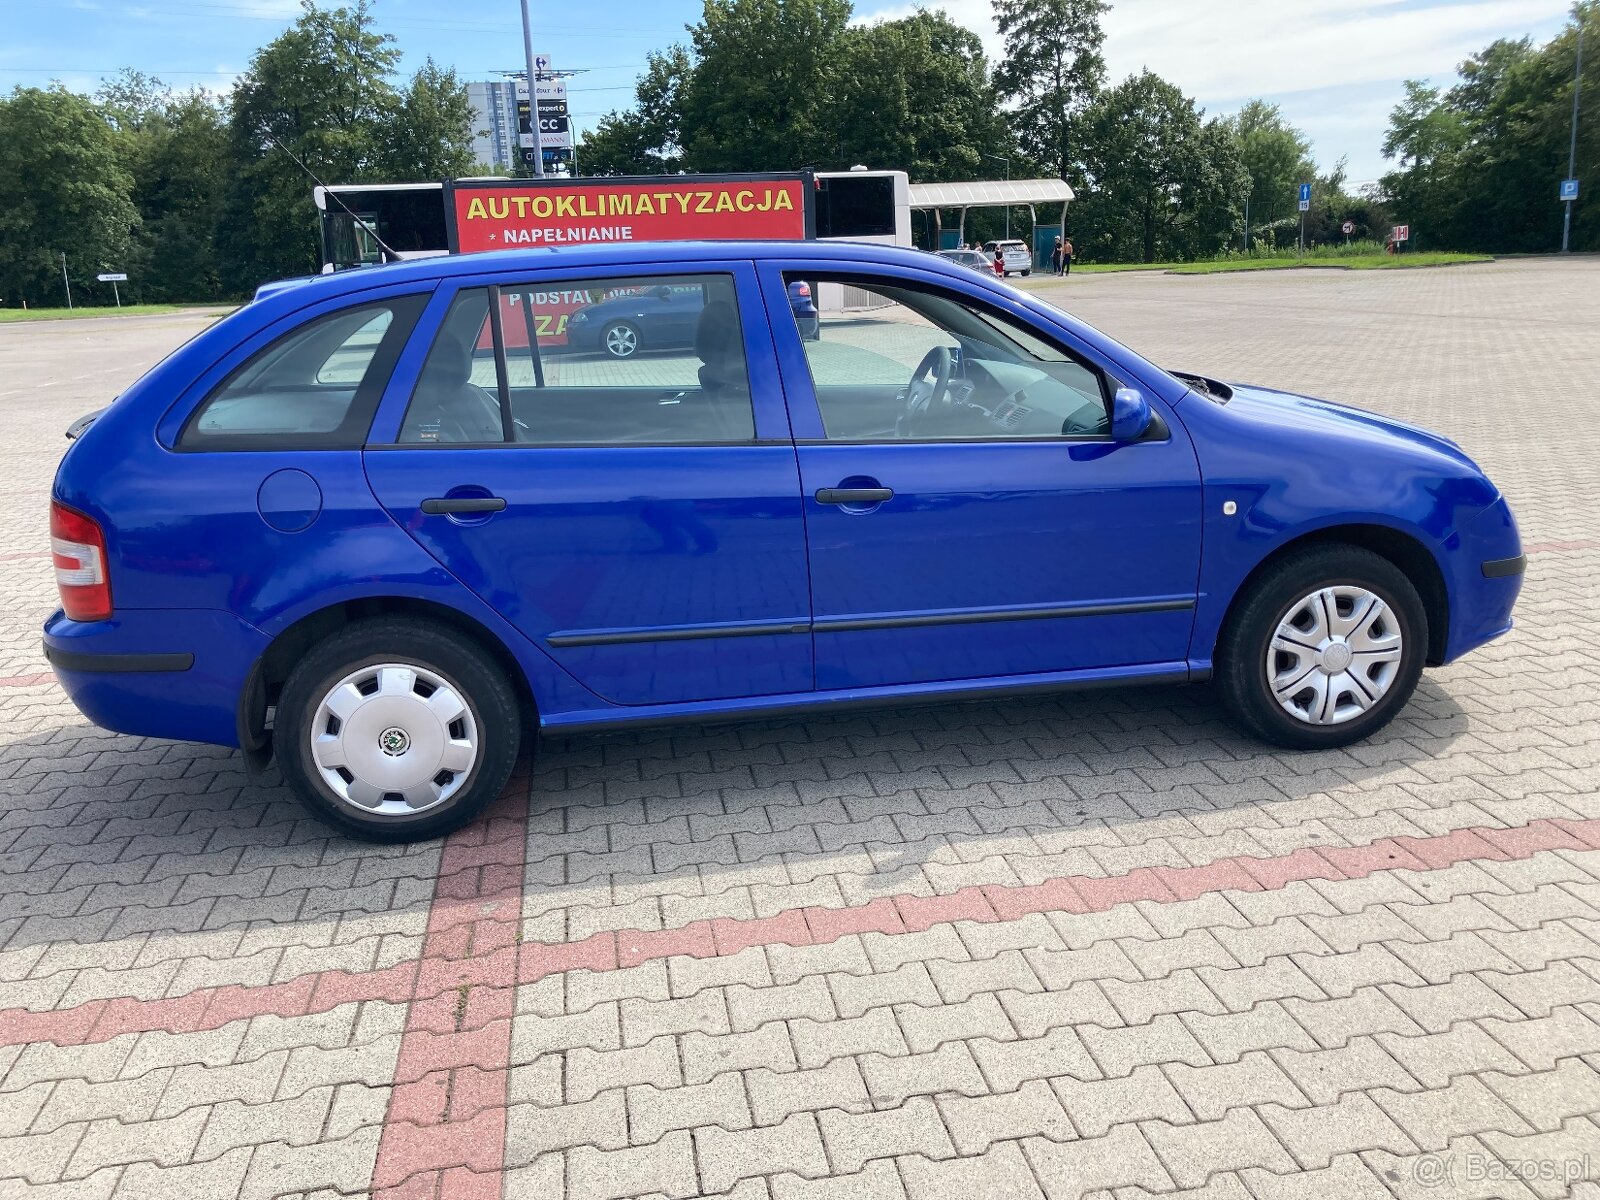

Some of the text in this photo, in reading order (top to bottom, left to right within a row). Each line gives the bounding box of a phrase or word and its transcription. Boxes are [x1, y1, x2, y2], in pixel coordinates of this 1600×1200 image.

[529, 119, 558, 130] CC
[1564, 182, 1575, 196] P
[466, 189, 794, 220] AUTOKLIMATYZACJA
[502, 226, 633, 244] NAPEŁNIANIE
